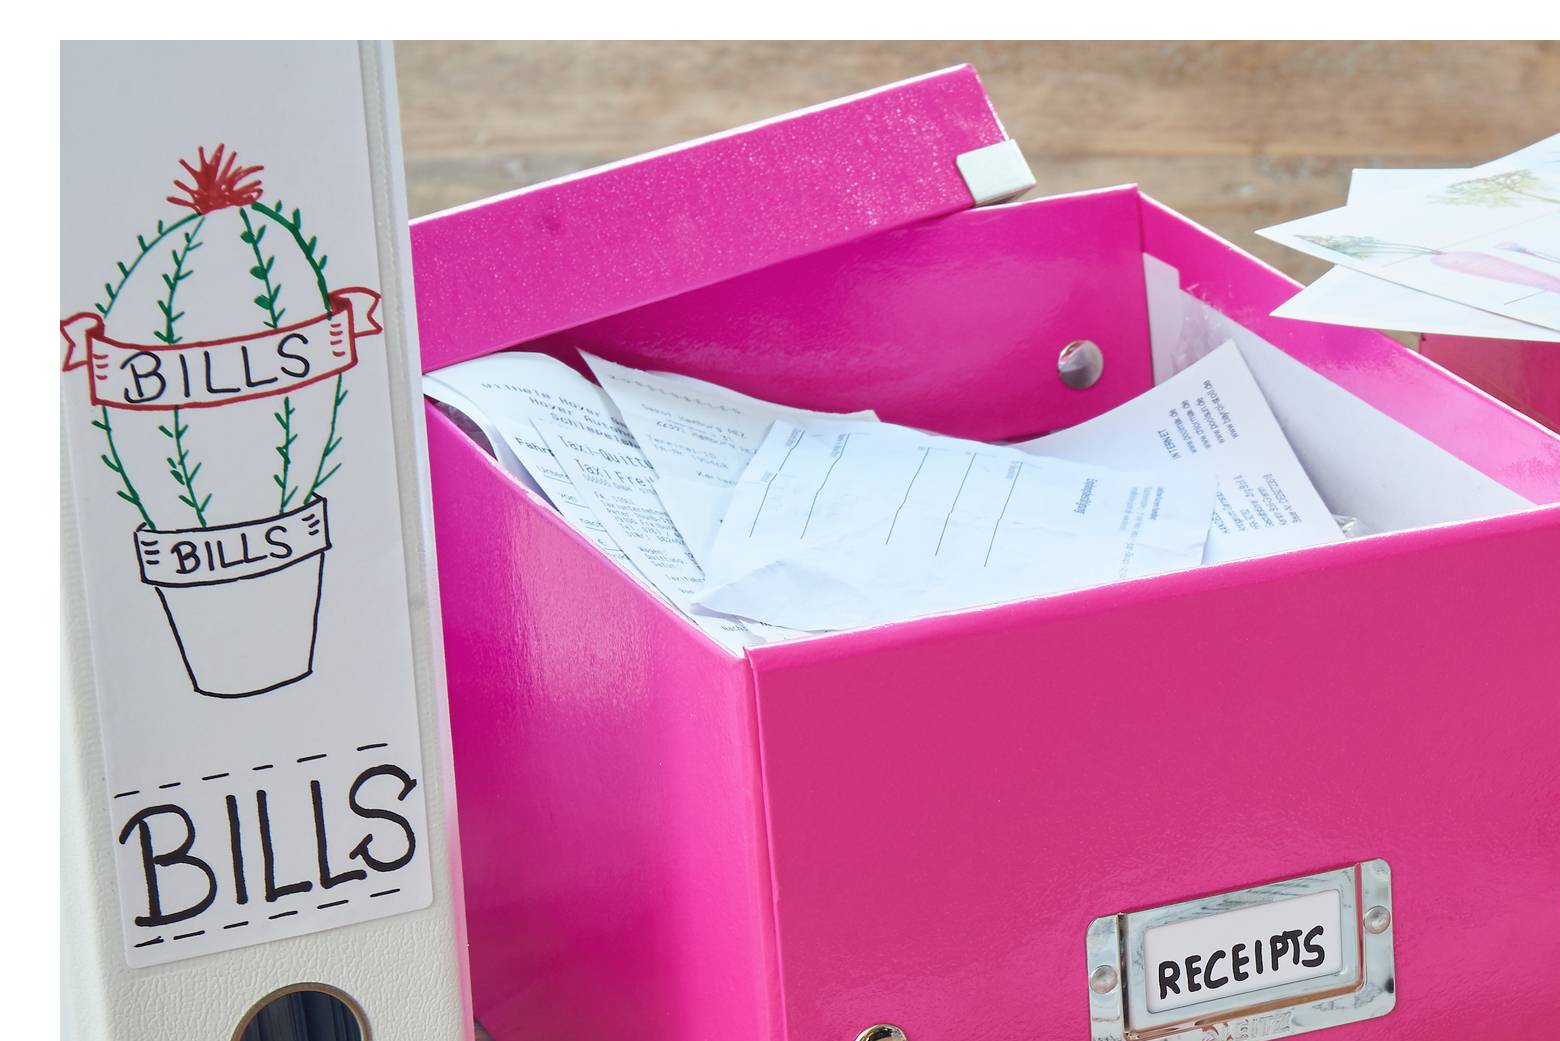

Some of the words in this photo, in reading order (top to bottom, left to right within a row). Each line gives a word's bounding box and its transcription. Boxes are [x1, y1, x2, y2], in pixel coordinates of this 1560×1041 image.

[121, 332, 313, 404] BILLS
[171, 534, 294, 575] BILLS
[119, 764, 417, 928] BILLS
[1158, 925, 1325, 1000] RECEIPTS
